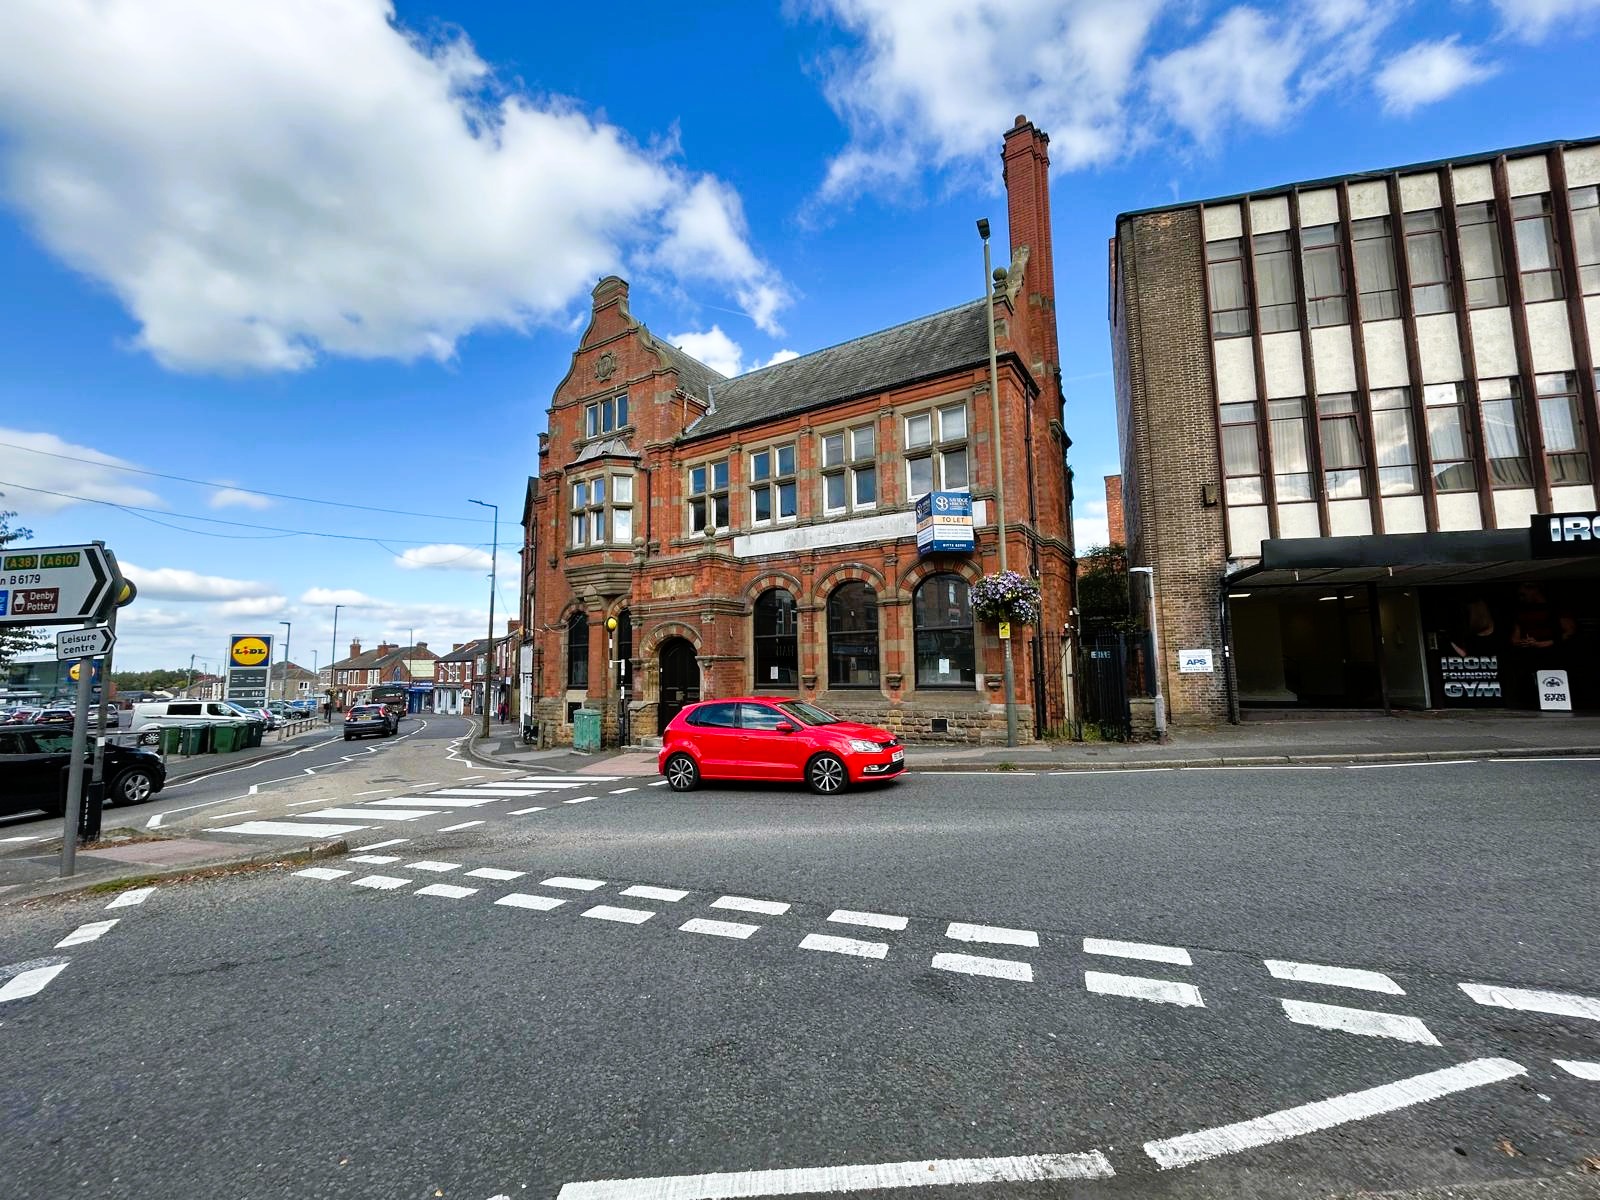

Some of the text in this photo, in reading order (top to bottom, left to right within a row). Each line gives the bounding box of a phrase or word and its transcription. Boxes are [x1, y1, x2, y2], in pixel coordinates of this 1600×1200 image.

[30, 591, 55, 601] Denby
[26, 602, 56, 611] Pottery
[61, 633, 97, 644] Leisure
[63, 644, 95, 654] centre
[1186, 658, 1207, 666] APS
[1441, 656, 1498, 670] IRON
[1442, 671, 1498, 680] FOUNDRY
[1444, 681, 1502, 697] GYM
